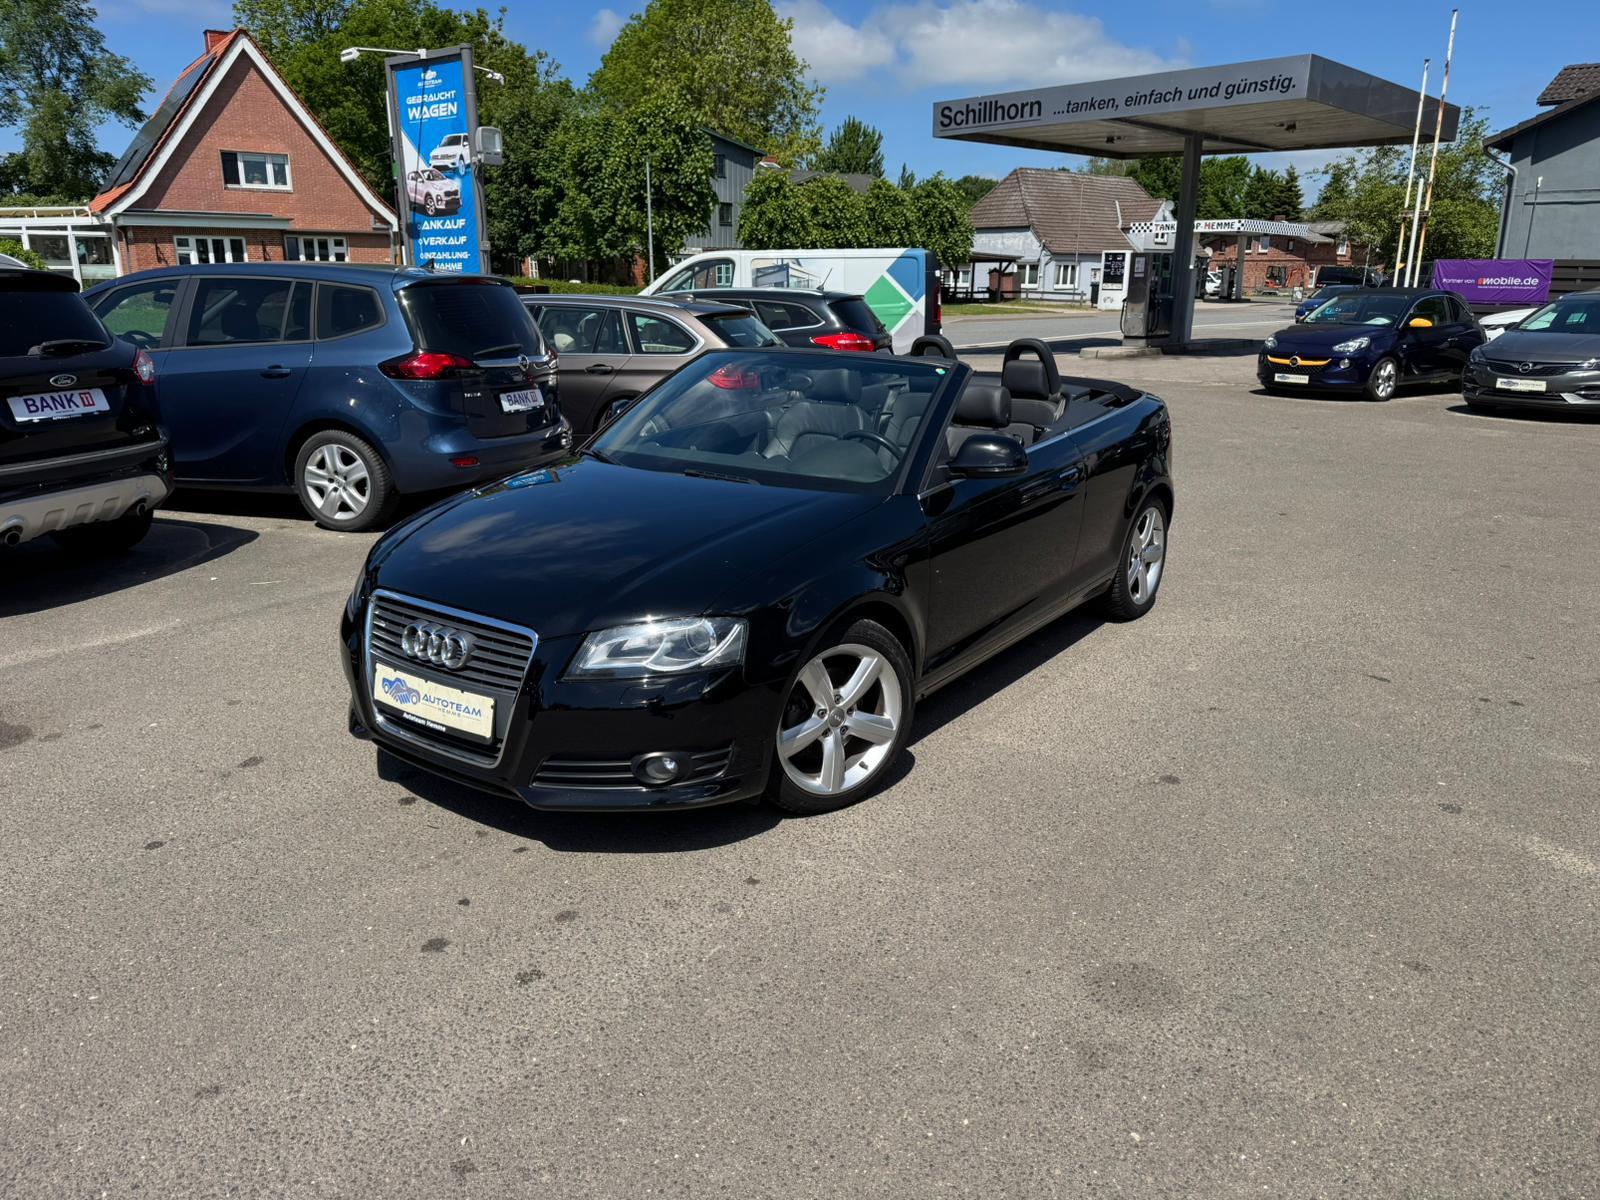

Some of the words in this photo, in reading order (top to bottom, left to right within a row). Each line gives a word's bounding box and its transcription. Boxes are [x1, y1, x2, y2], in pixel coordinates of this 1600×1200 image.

[406, 90, 456, 104] GEBRAUCHT
[940, 100, 1042, 128] Schillhorn
[1125, 87, 1183, 107] einfach
[1188, 80, 1221, 101] und
[1225, 74, 1297, 100] günstig.
[408, 102, 458, 120] WAGEN
[421, 219, 466, 231] ANKAUF
[422, 236, 467, 246] VERKAUF
[1483, 277, 1539, 285] mobile.de
[23, 393, 79, 414] BANK
[81, 392, 95, 407] 11
[507, 392, 530, 406] BANK
[422, 694, 482, 717] AUTOTEAM
